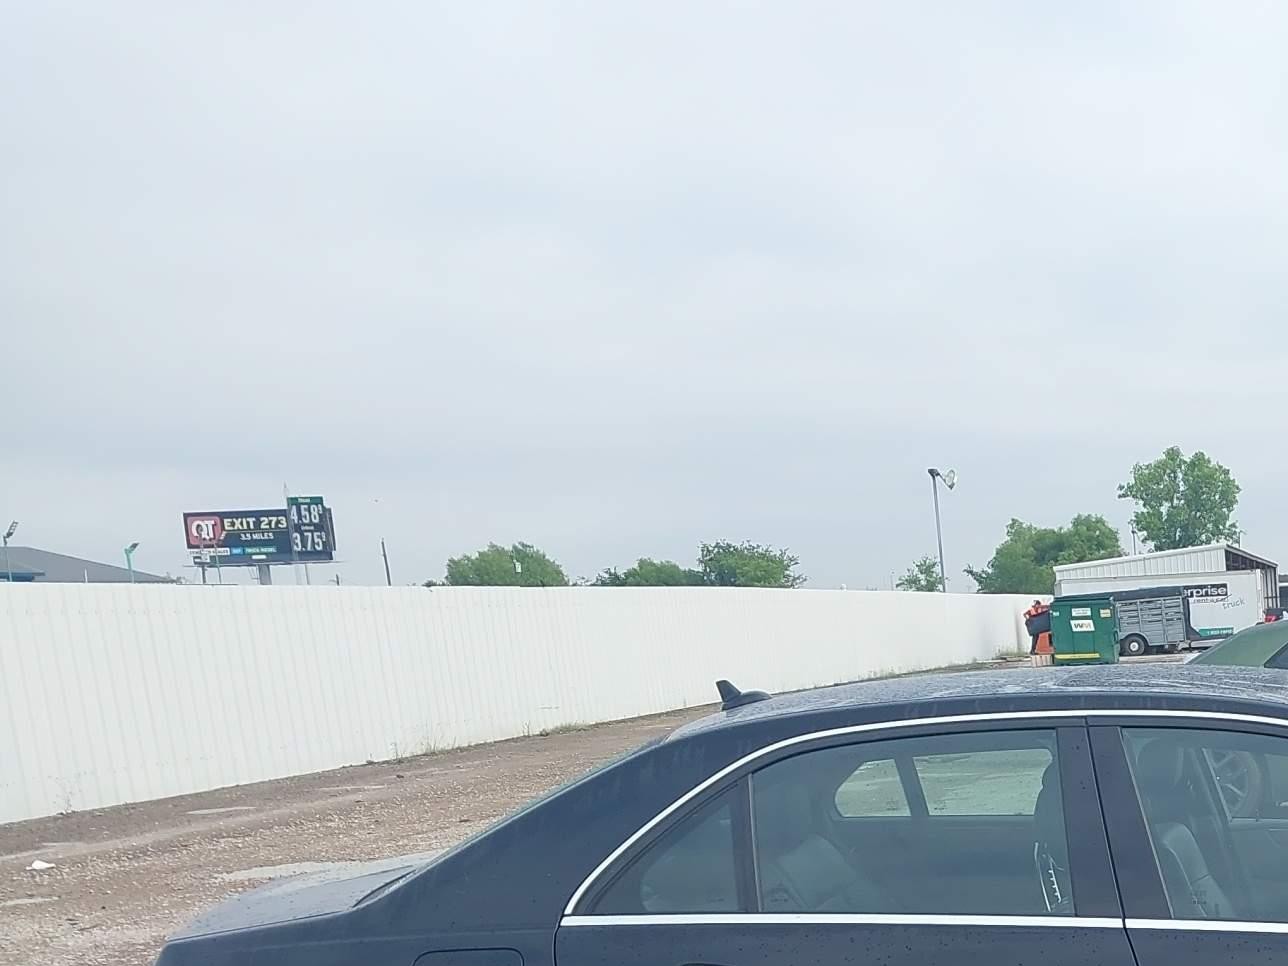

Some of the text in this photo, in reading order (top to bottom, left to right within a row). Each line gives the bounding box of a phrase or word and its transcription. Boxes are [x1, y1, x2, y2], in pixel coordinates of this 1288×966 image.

[191, 520, 216, 540] QT
[223, 516, 287, 530] EXIT 273
[252, 532, 274, 540] MILES
